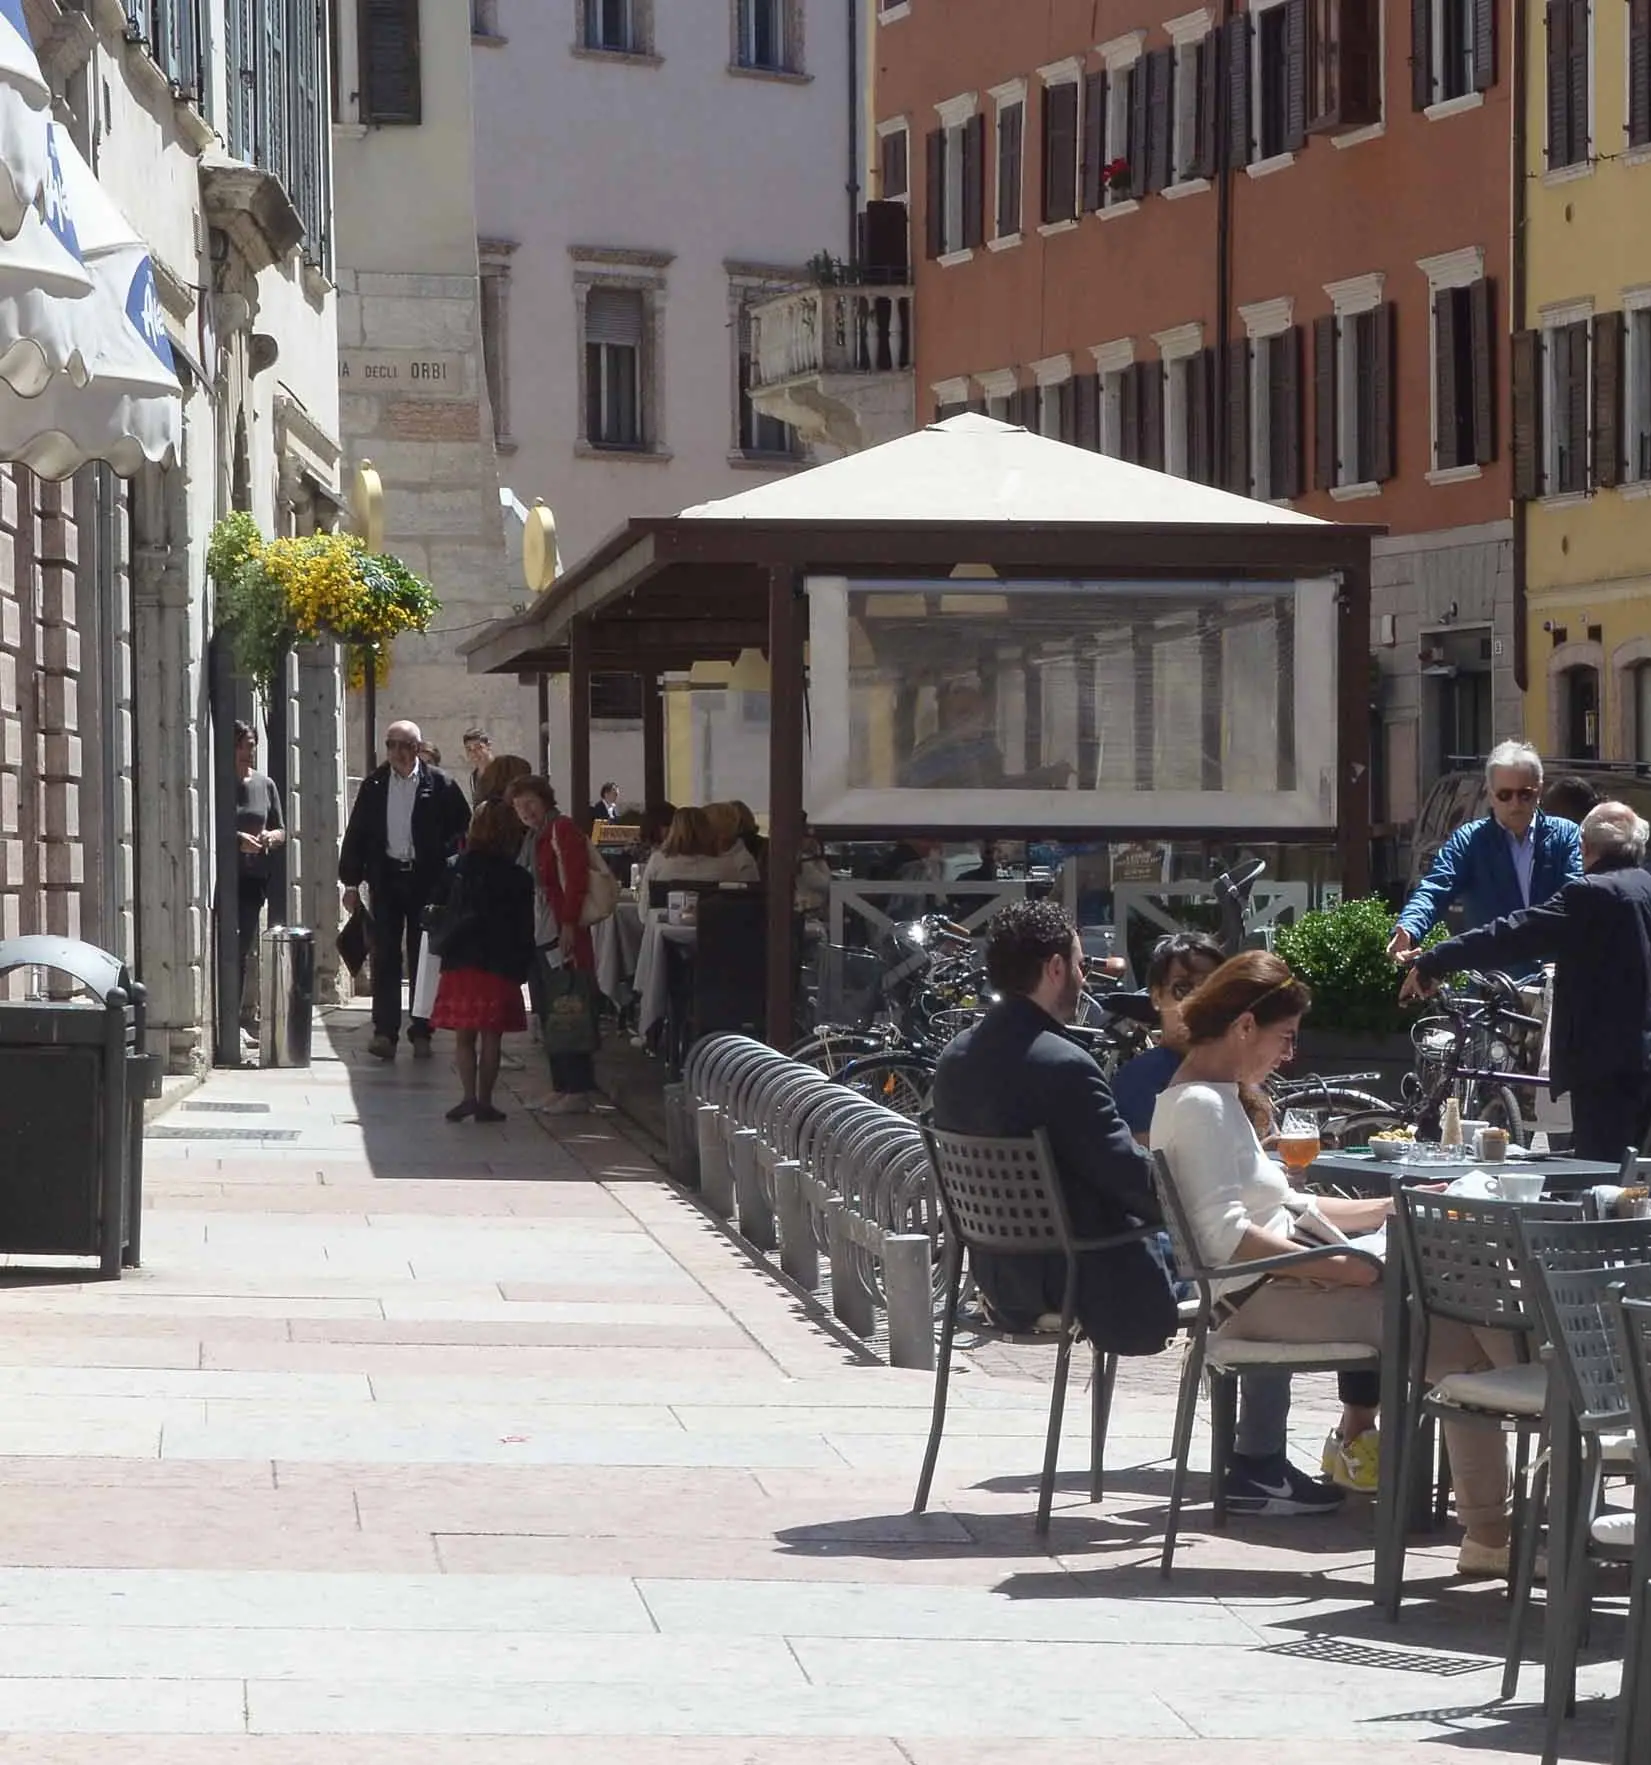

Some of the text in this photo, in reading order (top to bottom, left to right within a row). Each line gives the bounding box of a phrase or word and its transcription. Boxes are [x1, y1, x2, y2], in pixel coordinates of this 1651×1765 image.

[337, 360, 447, 380] IA DEGLI ORBI
